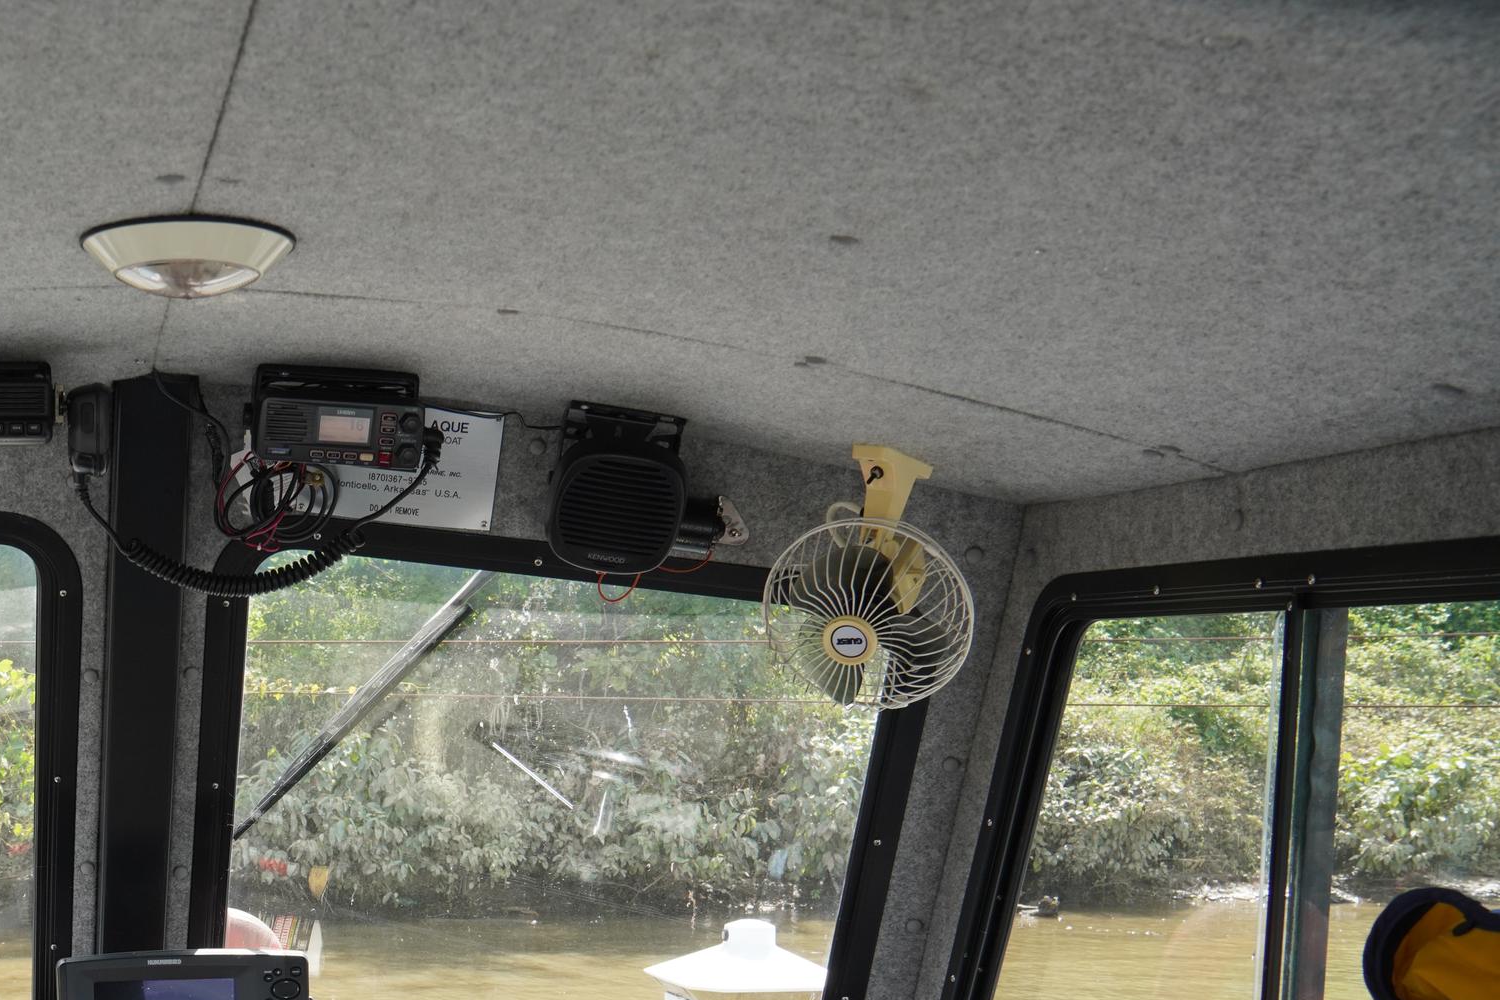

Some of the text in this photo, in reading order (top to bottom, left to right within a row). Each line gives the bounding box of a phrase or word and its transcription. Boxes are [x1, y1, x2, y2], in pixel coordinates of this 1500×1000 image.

[430, 419, 470, 434] AQUE
[444, 436, 463, 446] OAT
[337, 478, 380, 492] onticello,
[383, 484, 426, 496] Arkasas
[395, 506, 419, 517] REMOVE
[587, 552, 625, 564] KENWOOD
